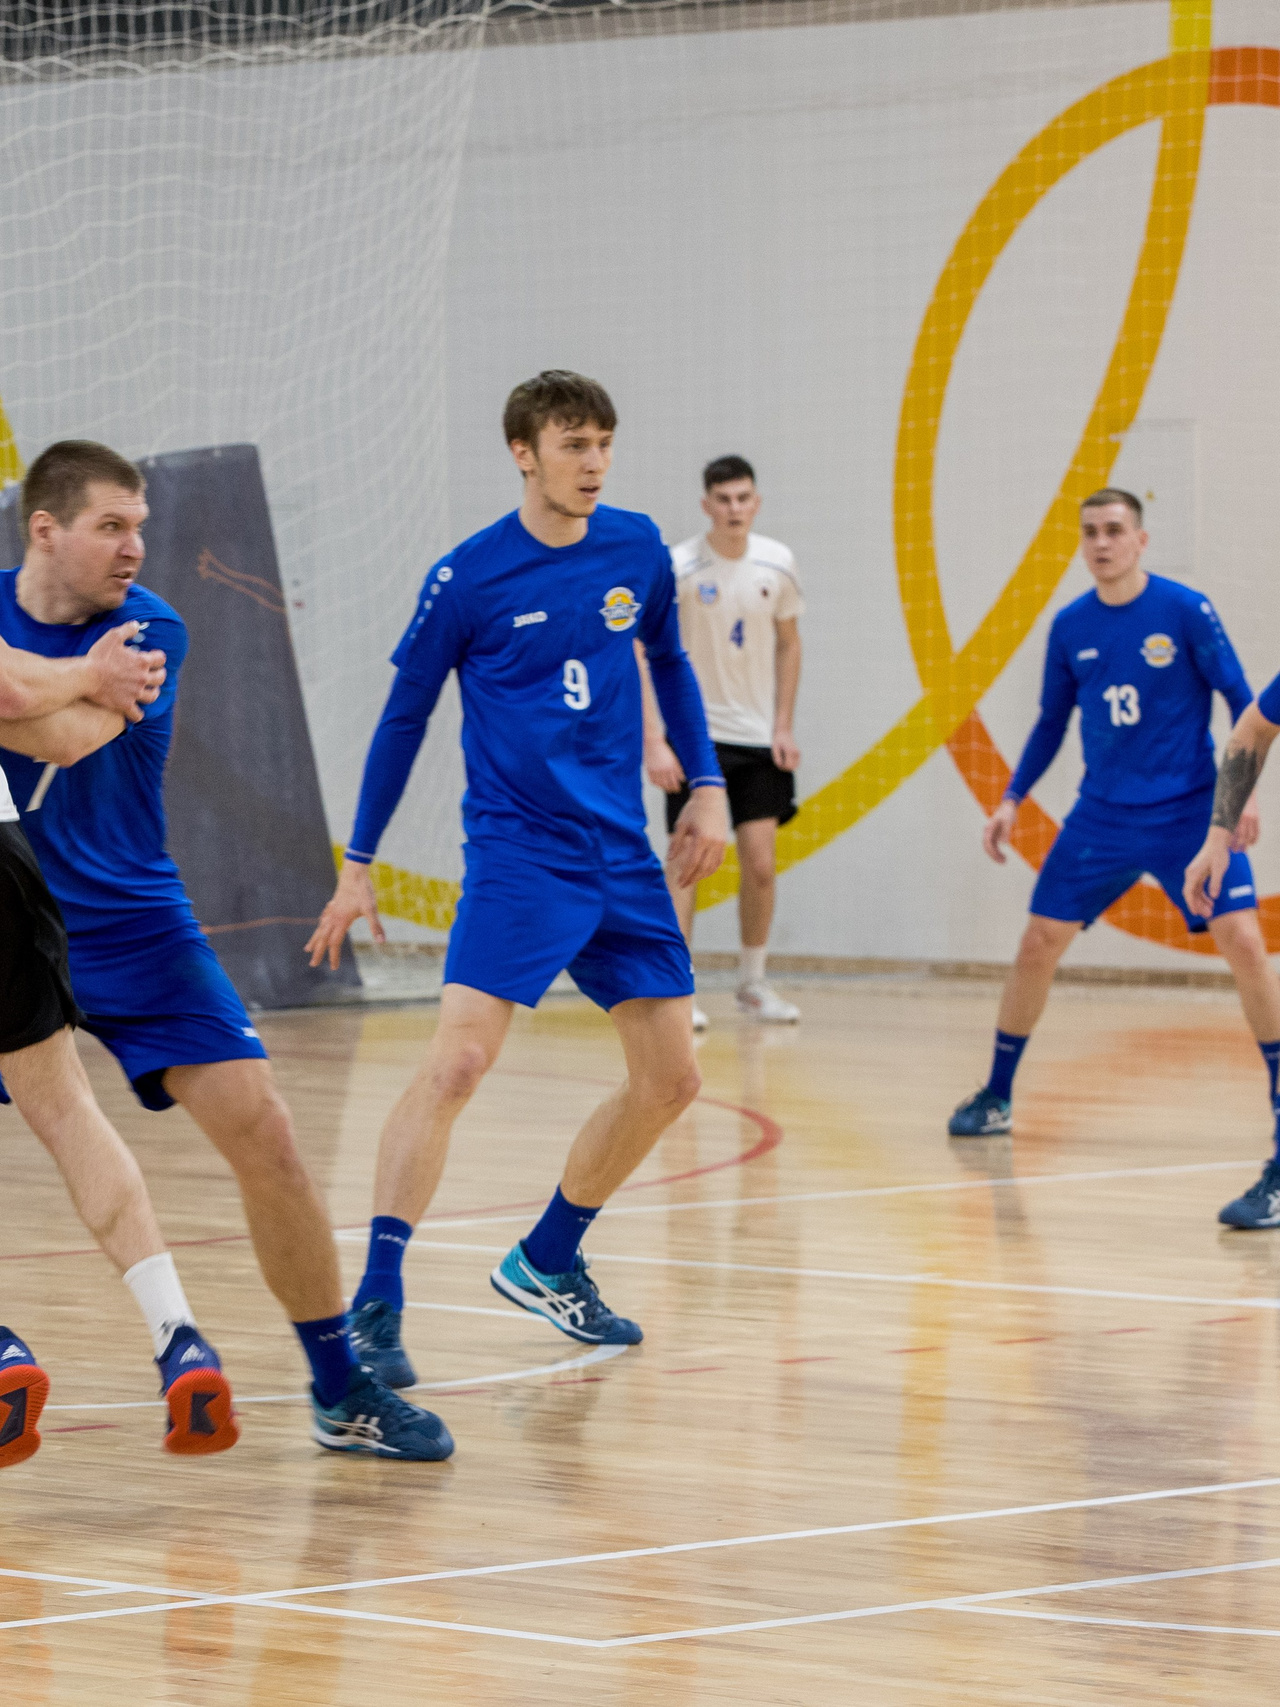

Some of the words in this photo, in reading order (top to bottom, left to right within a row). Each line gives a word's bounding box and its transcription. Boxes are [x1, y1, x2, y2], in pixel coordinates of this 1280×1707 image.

[730, 617, 745, 649] 4
[563, 659, 591, 710] 9
[1102, 684, 1141, 727] 13
